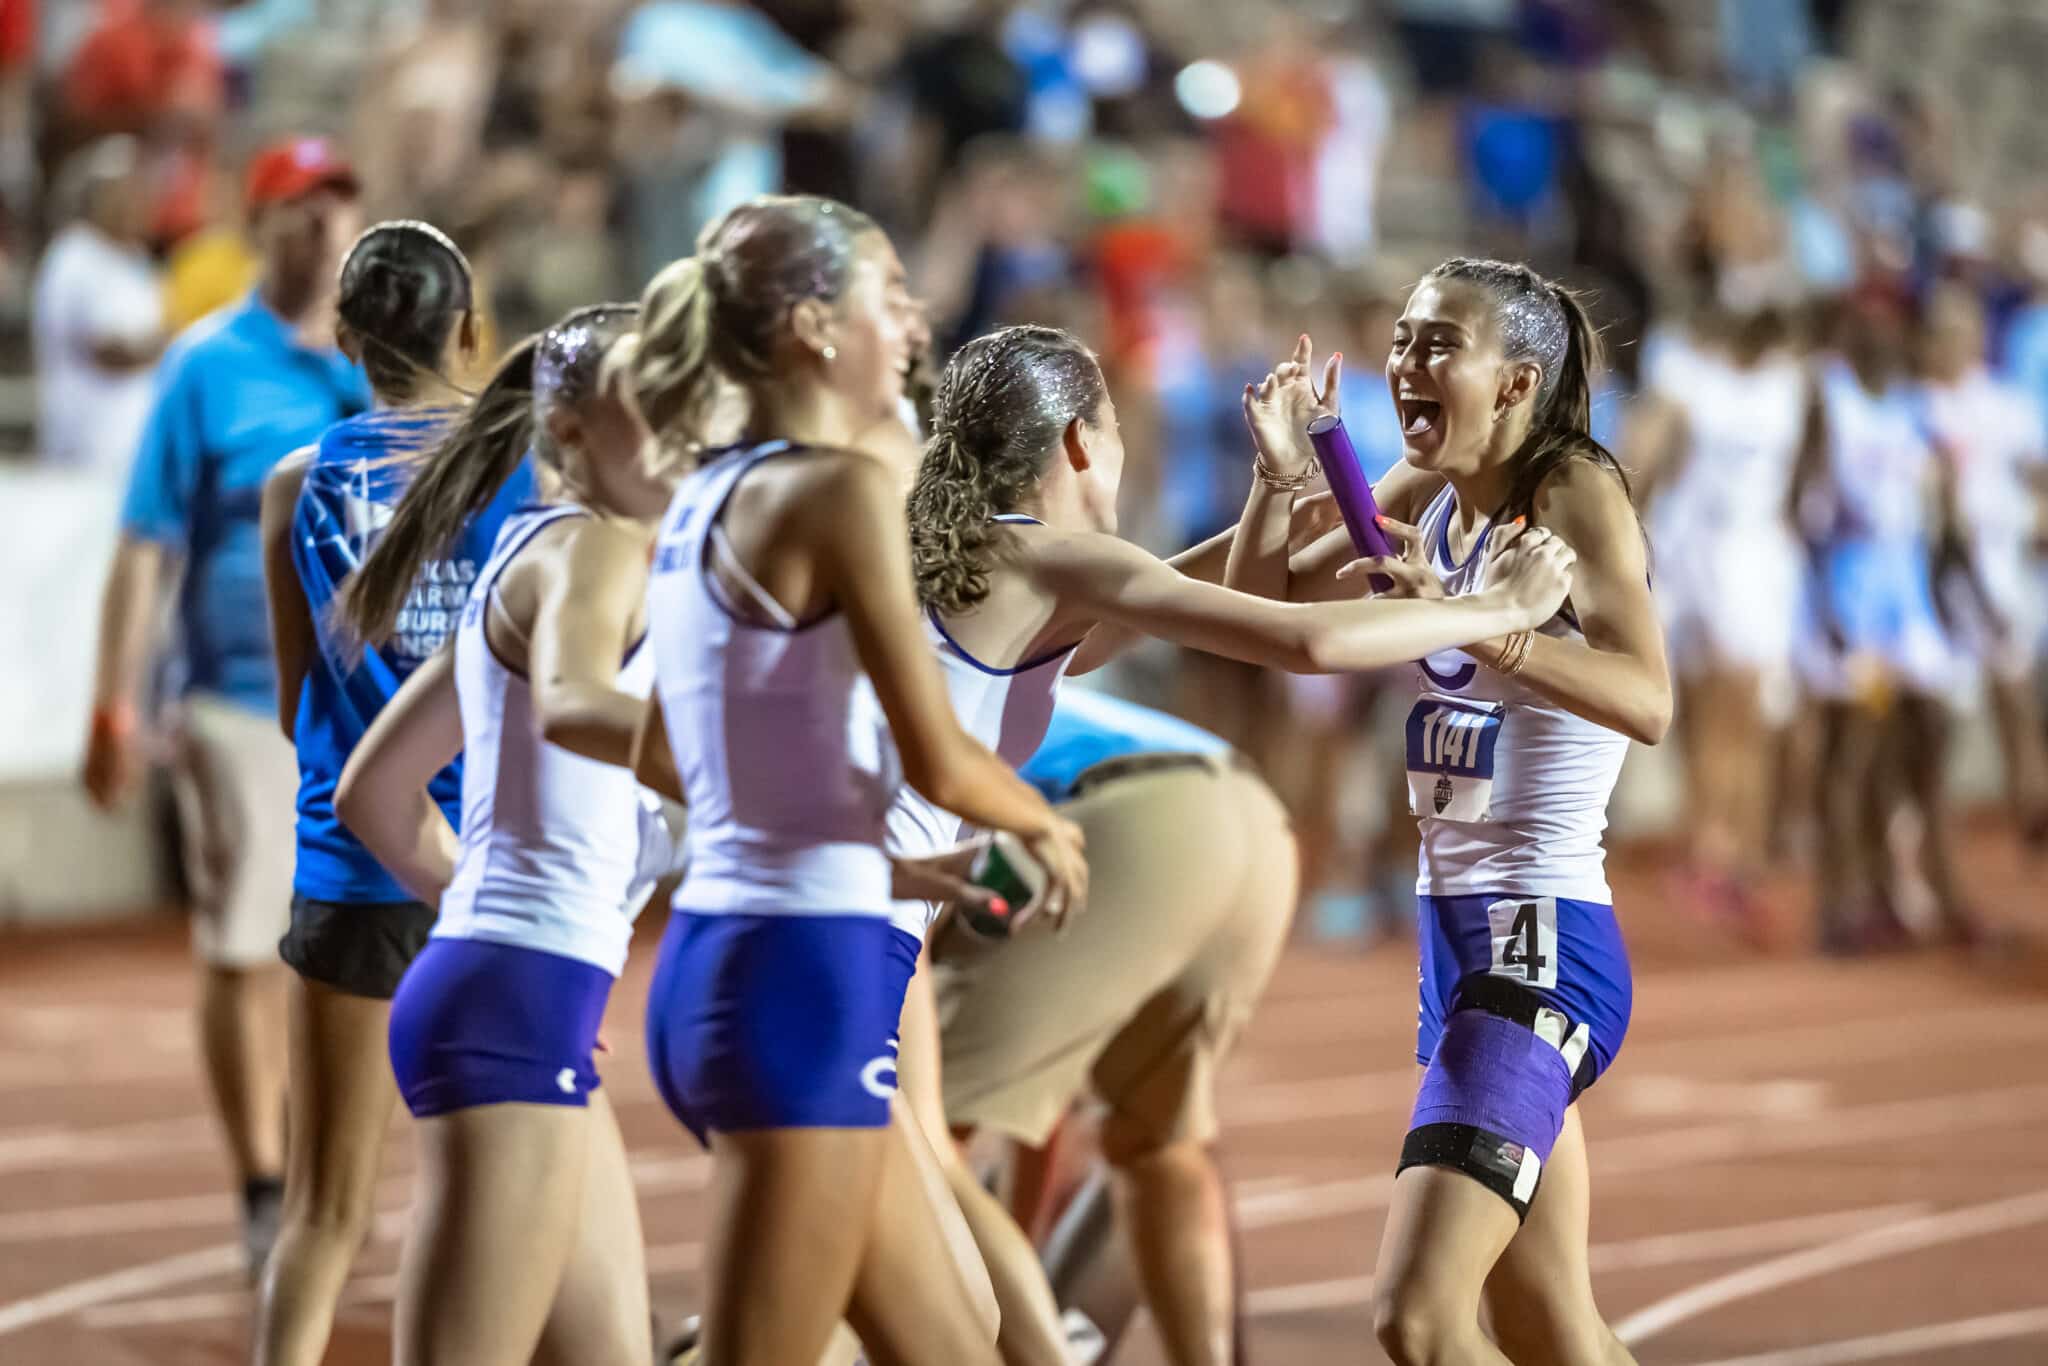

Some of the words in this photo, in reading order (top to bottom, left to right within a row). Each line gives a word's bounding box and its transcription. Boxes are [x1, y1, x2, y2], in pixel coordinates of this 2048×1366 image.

[405, 585, 468, 608] ARM
[1423, 707, 1489, 769] 1141
[1503, 903, 1547, 982] 4
